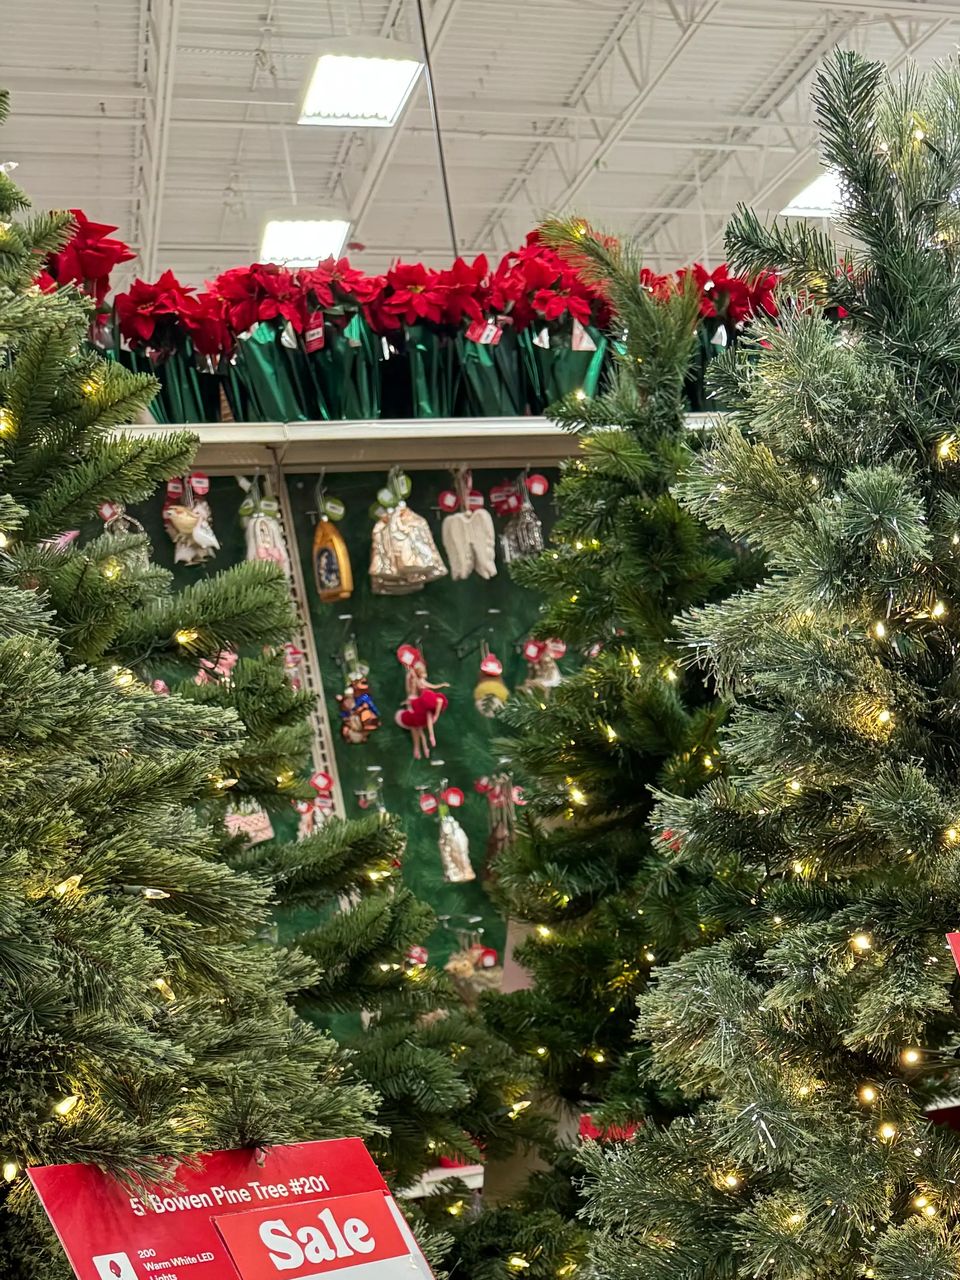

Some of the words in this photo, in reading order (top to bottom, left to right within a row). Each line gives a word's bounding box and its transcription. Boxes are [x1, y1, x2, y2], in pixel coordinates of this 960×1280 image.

[148, 1193, 214, 1214] Bowen
[211, 1188, 252, 1205] Pine
[248, 1184, 289, 1200] Tree
[288, 1176, 330, 1195] #201
[259, 1207, 375, 1272] Sale
